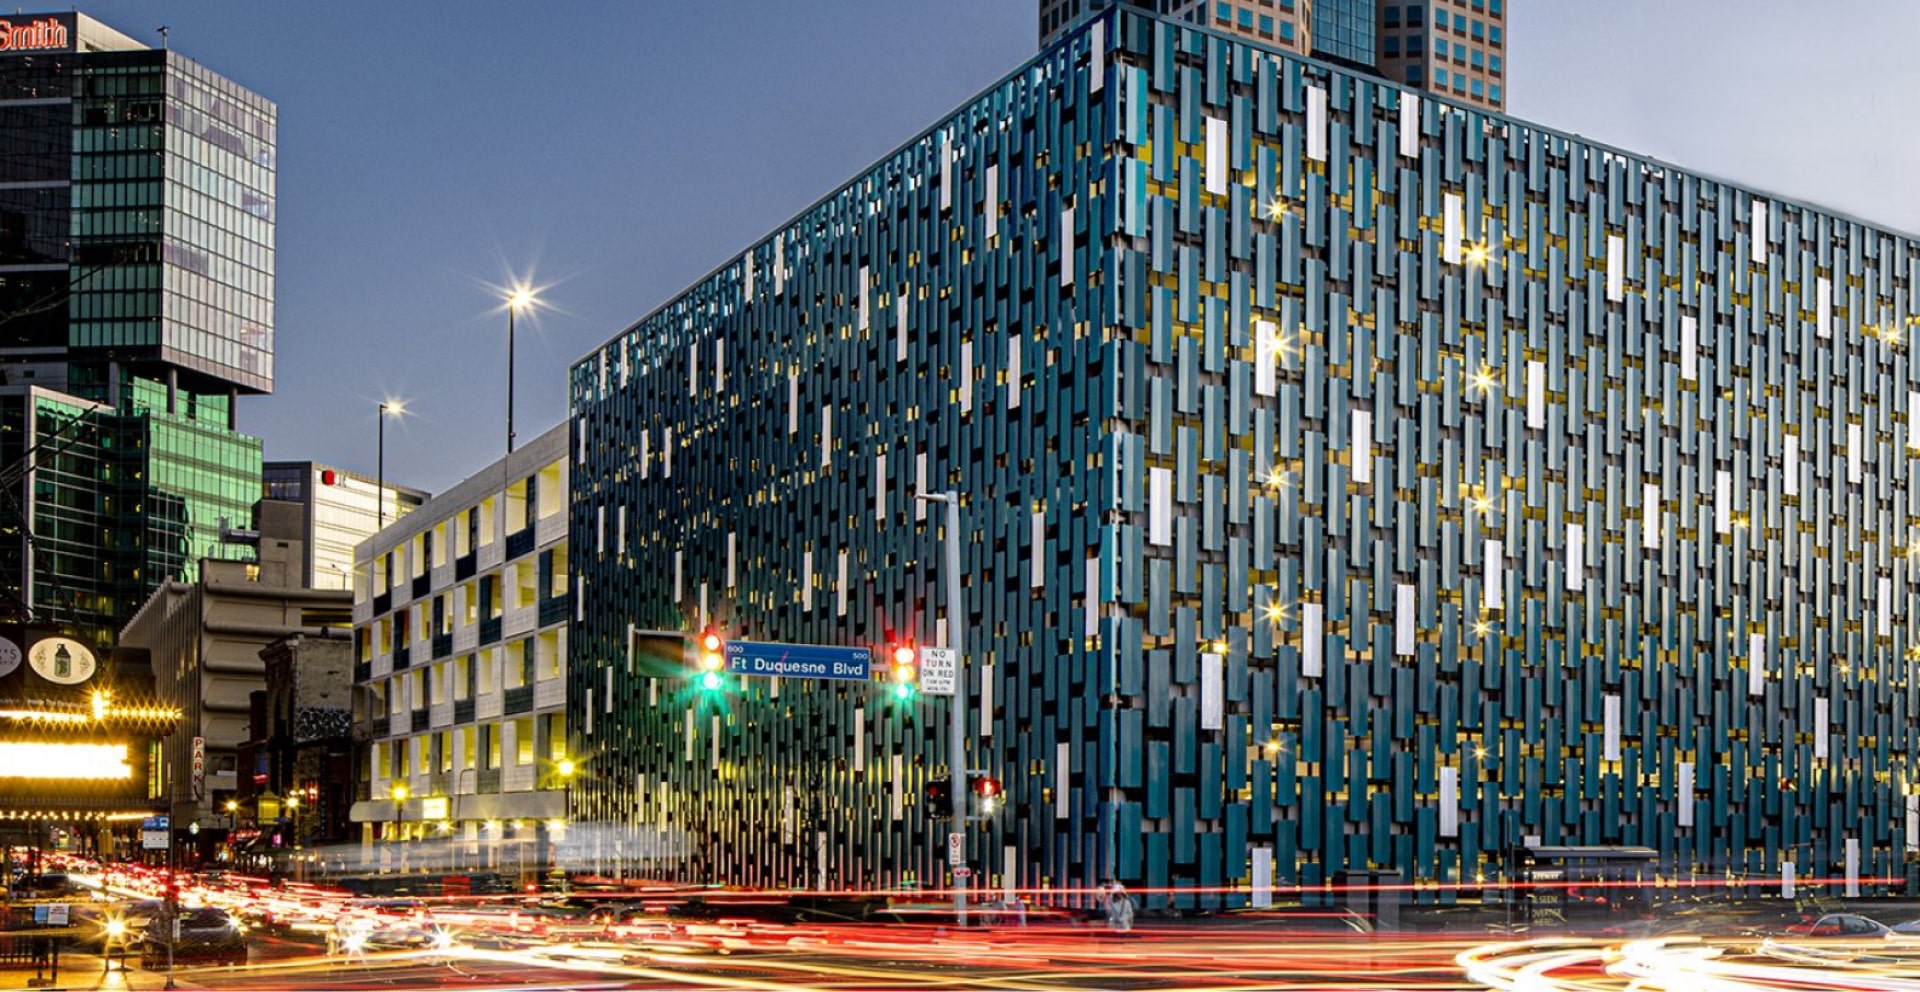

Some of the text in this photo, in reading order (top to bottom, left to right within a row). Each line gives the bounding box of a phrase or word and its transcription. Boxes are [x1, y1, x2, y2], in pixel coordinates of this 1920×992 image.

[0, 16, 68, 51] Smith
[727, 645, 744, 653] 600
[931, 650, 946, 658] NO
[731, 657, 864, 675] Ft Duquesne Blvd
[926, 659, 952, 668] TURN
[923, 668, 954, 678] ON RED
